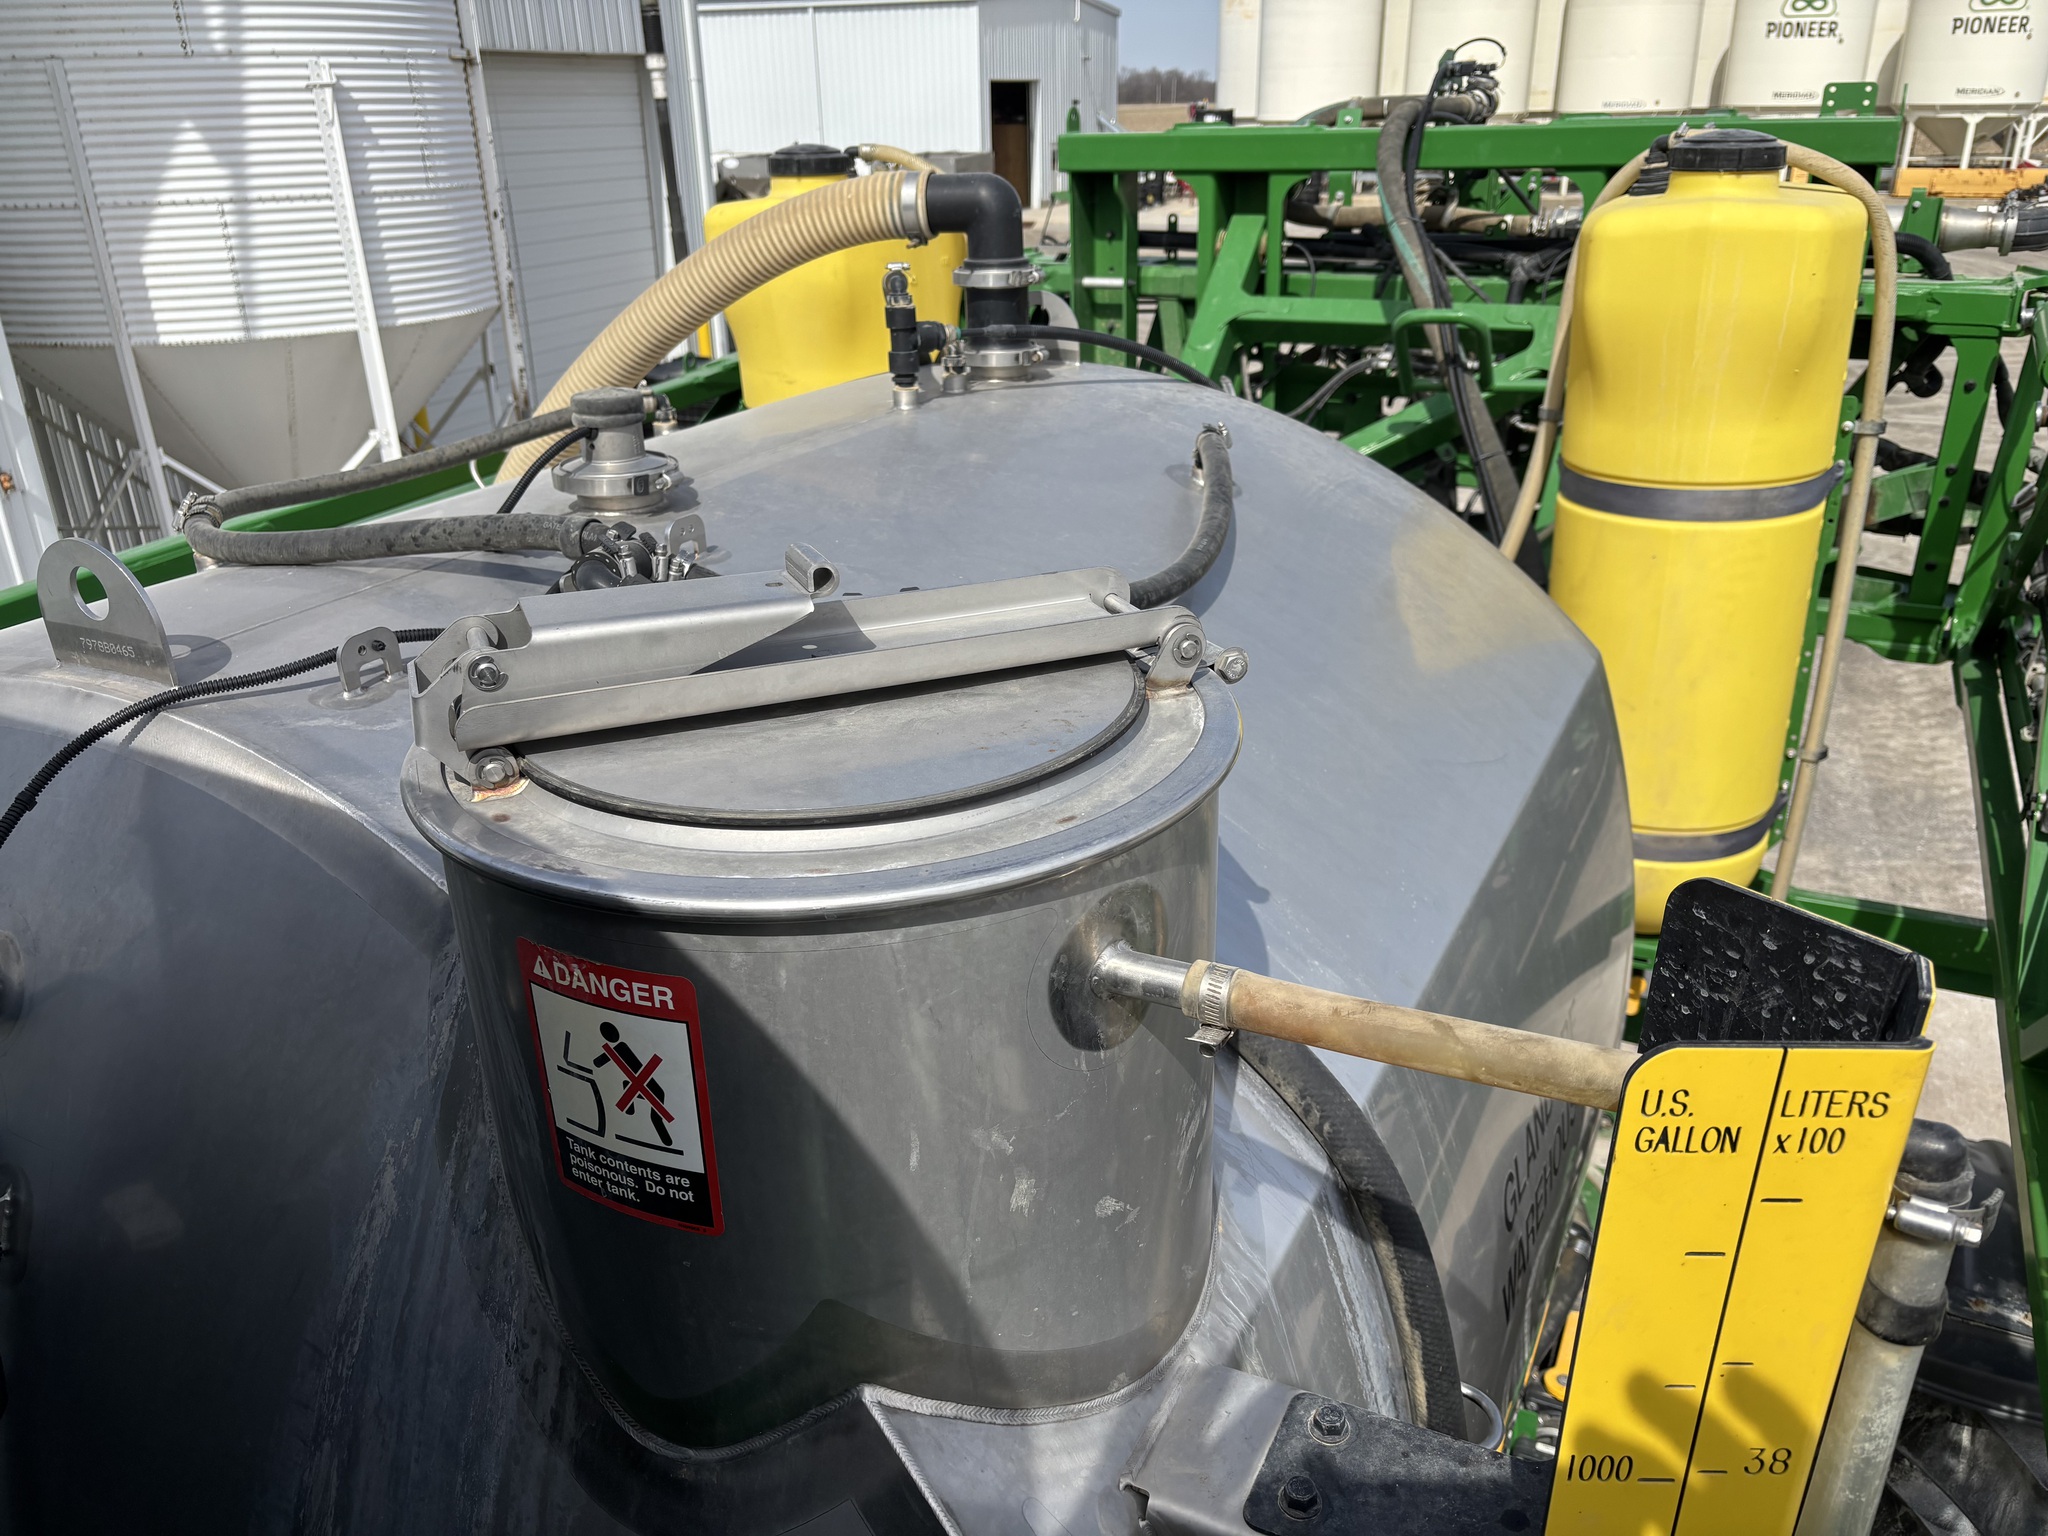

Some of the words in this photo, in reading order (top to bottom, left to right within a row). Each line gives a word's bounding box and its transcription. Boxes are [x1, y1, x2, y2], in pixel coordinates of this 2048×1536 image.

[1765, 20, 1839, 39] PIONEER
[1951, 15, 2030, 35] PIONEER
[542, 521, 561, 531] GATE
[553, 960, 676, 1011] DANGER
[1640, 1088, 1694, 1118] U.S.
[1780, 1089, 1891, 1119] LITERS
[1634, 1125, 1743, 1154] GALLON
[565, 1136, 597, 1160] Tank
[599, 1154, 661, 1181] contents
[665, 1174, 691, 1188] are
[1503, 1097, 1553, 1233] GLAND
[569, 1152, 639, 1189] poisonous.
[645, 1180, 666, 1196] Do
[669, 1188, 695, 1203] not
[571, 1167, 603, 1188] enter
[606, 1181, 640, 1202] tank.
[1502, 1103, 1577, 1327] WAREHOUS
[1566, 1453, 1634, 1482] 1000
[1743, 1447, 1792, 1475] 38
